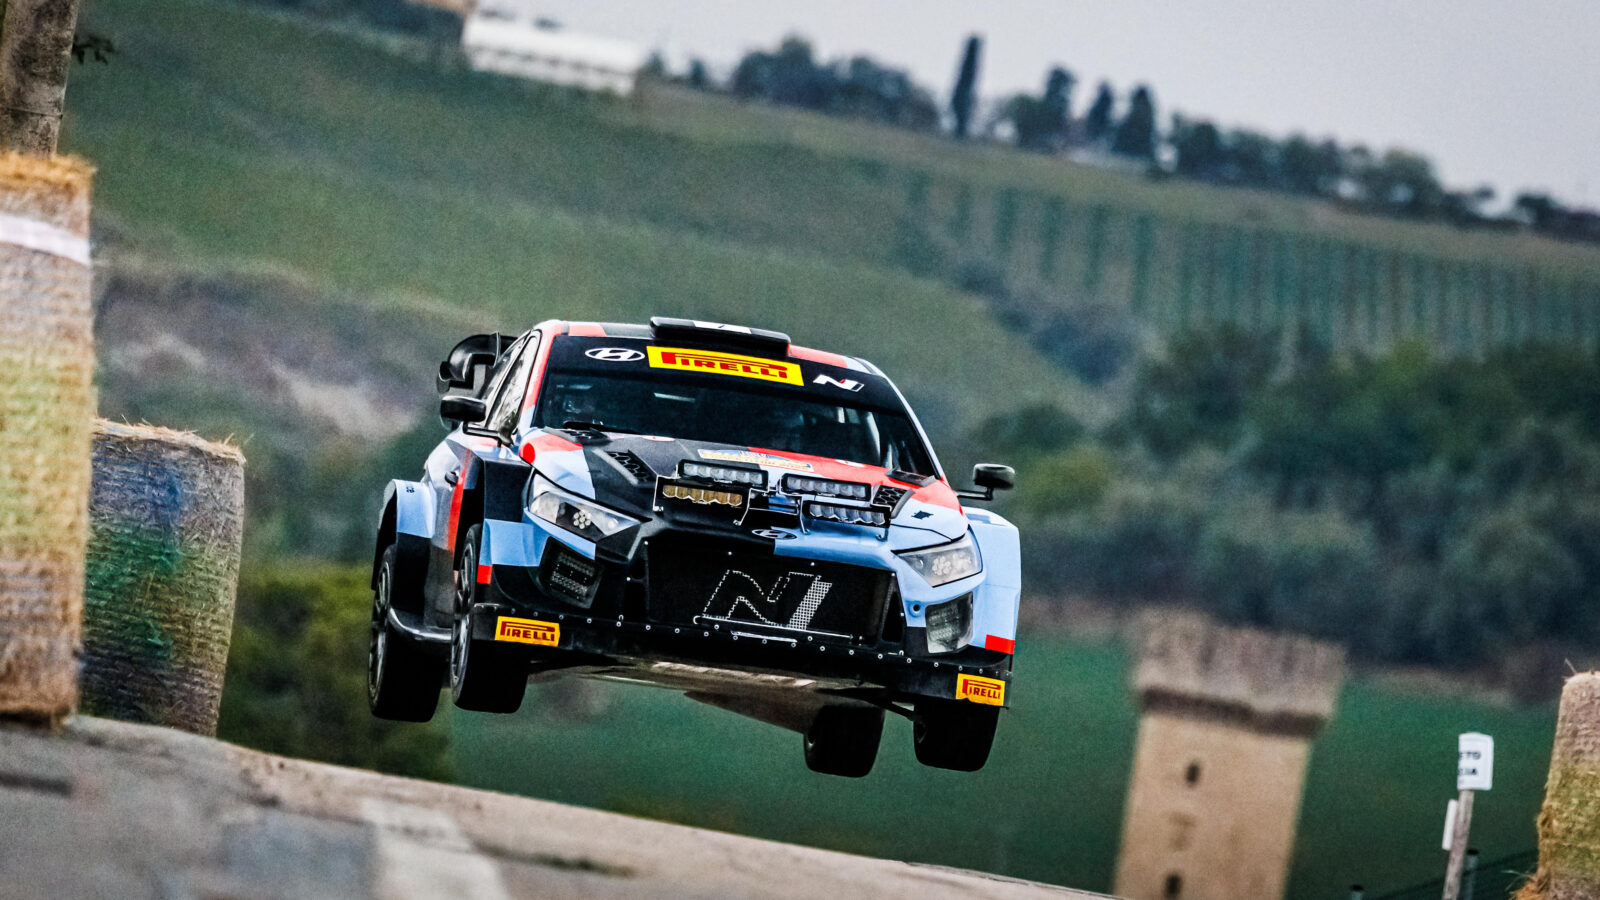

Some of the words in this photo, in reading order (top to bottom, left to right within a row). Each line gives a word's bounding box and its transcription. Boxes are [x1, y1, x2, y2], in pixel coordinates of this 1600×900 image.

[660, 351, 788, 379] PIRELLI
[500, 620, 556, 641] PIRELLI
[962, 678, 1002, 700] PIRELLI
